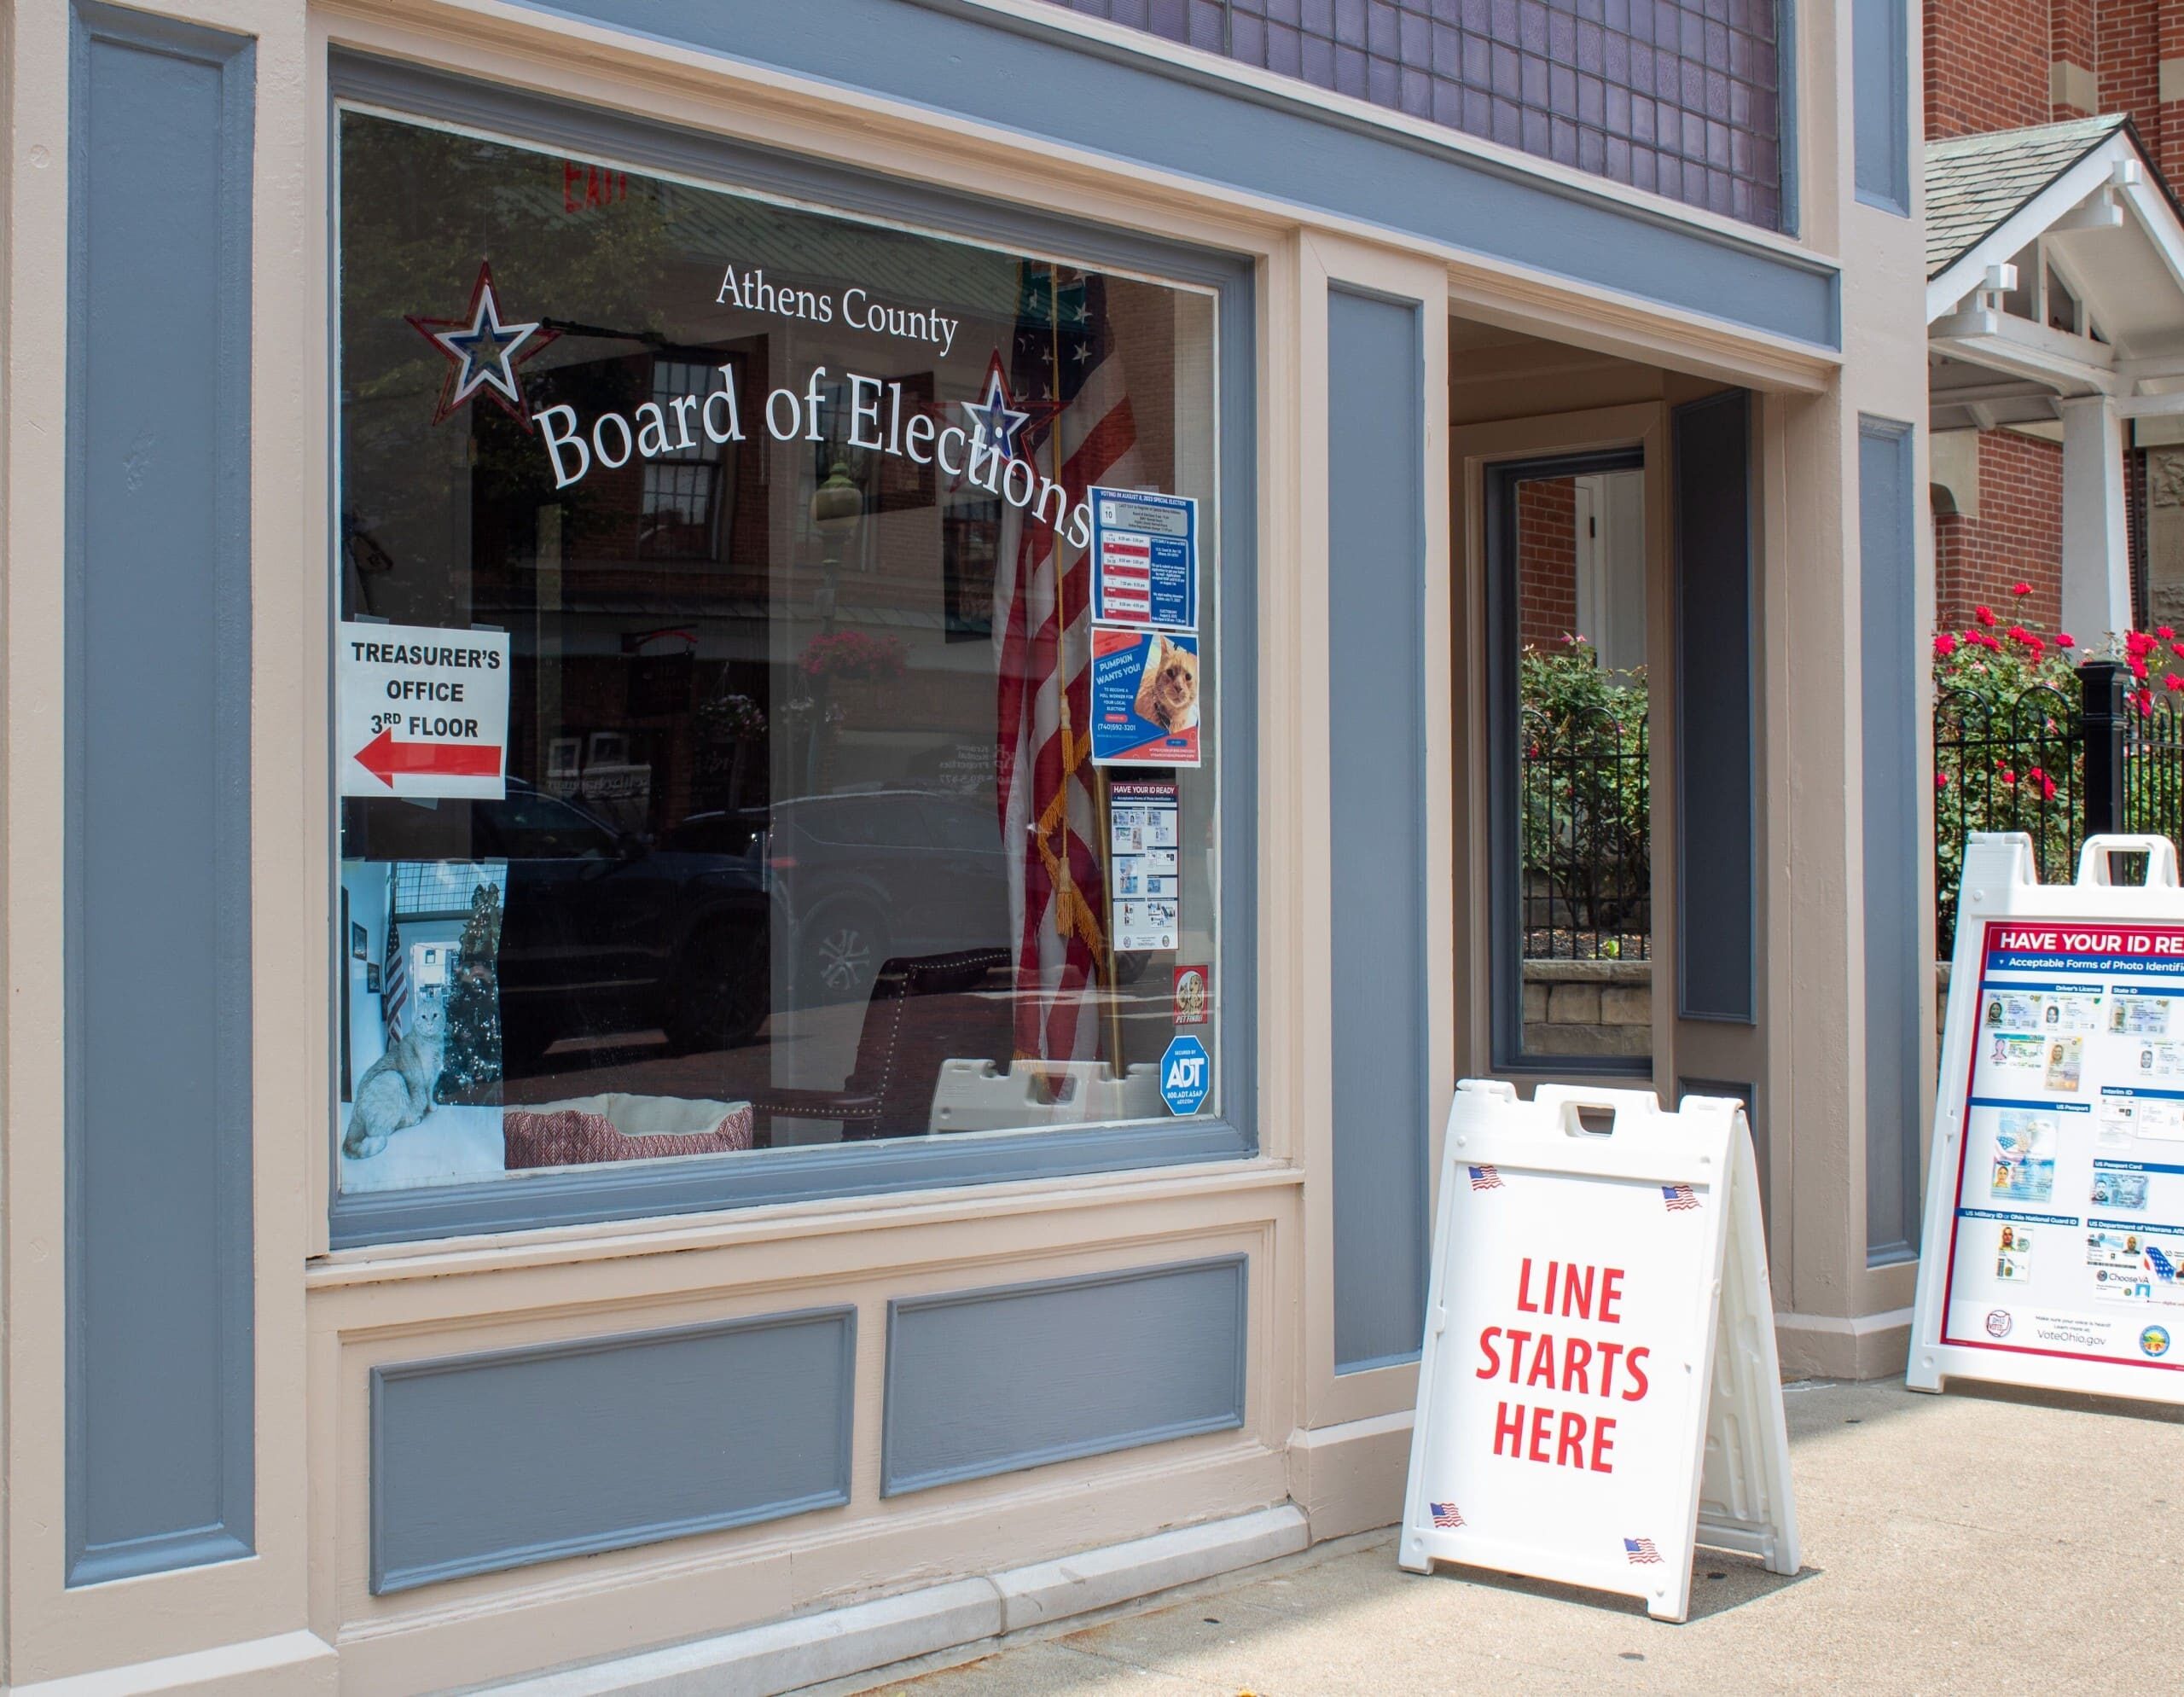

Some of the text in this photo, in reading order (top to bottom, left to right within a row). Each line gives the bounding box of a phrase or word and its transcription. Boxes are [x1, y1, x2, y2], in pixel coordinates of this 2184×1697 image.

[717, 264, 959, 357] Athens County
[532, 363, 1092, 549] Board of Elections
[351, 642, 501, 670] TREASURER'S
[1100, 654, 1133, 672] PUMPKIN
[1096, 663, 1141, 686] WANTS YOU!
[386, 679, 464, 702] OFFICE
[371, 712, 479, 738] 3RD FLOOR
[1097, 723, 1136, 731] (740)592-3201
[2000, 933, 2184, 954] HAVE YOUR ID RE
[2008, 957, 2065, 970] Acceptable
[2066, 959, 2098, 969] Forms
[2100, 960, 2111, 970] of
[2113, 961, 2144, 971] Photo
[1176, 1015, 1187, 1024] PET
[1165, 1058, 1205, 1089] ADT
[2098, 1222, 2135, 1230] Department
[2145, 1225, 2171, 1234] Veterans
[1517, 1257, 1625, 1325] LINE
[2037, 1329, 2106, 1345] VoteOhio.gov
[1476, 1326, 1651, 1402] STARTS
[1493, 1402, 1618, 1473] HERE
